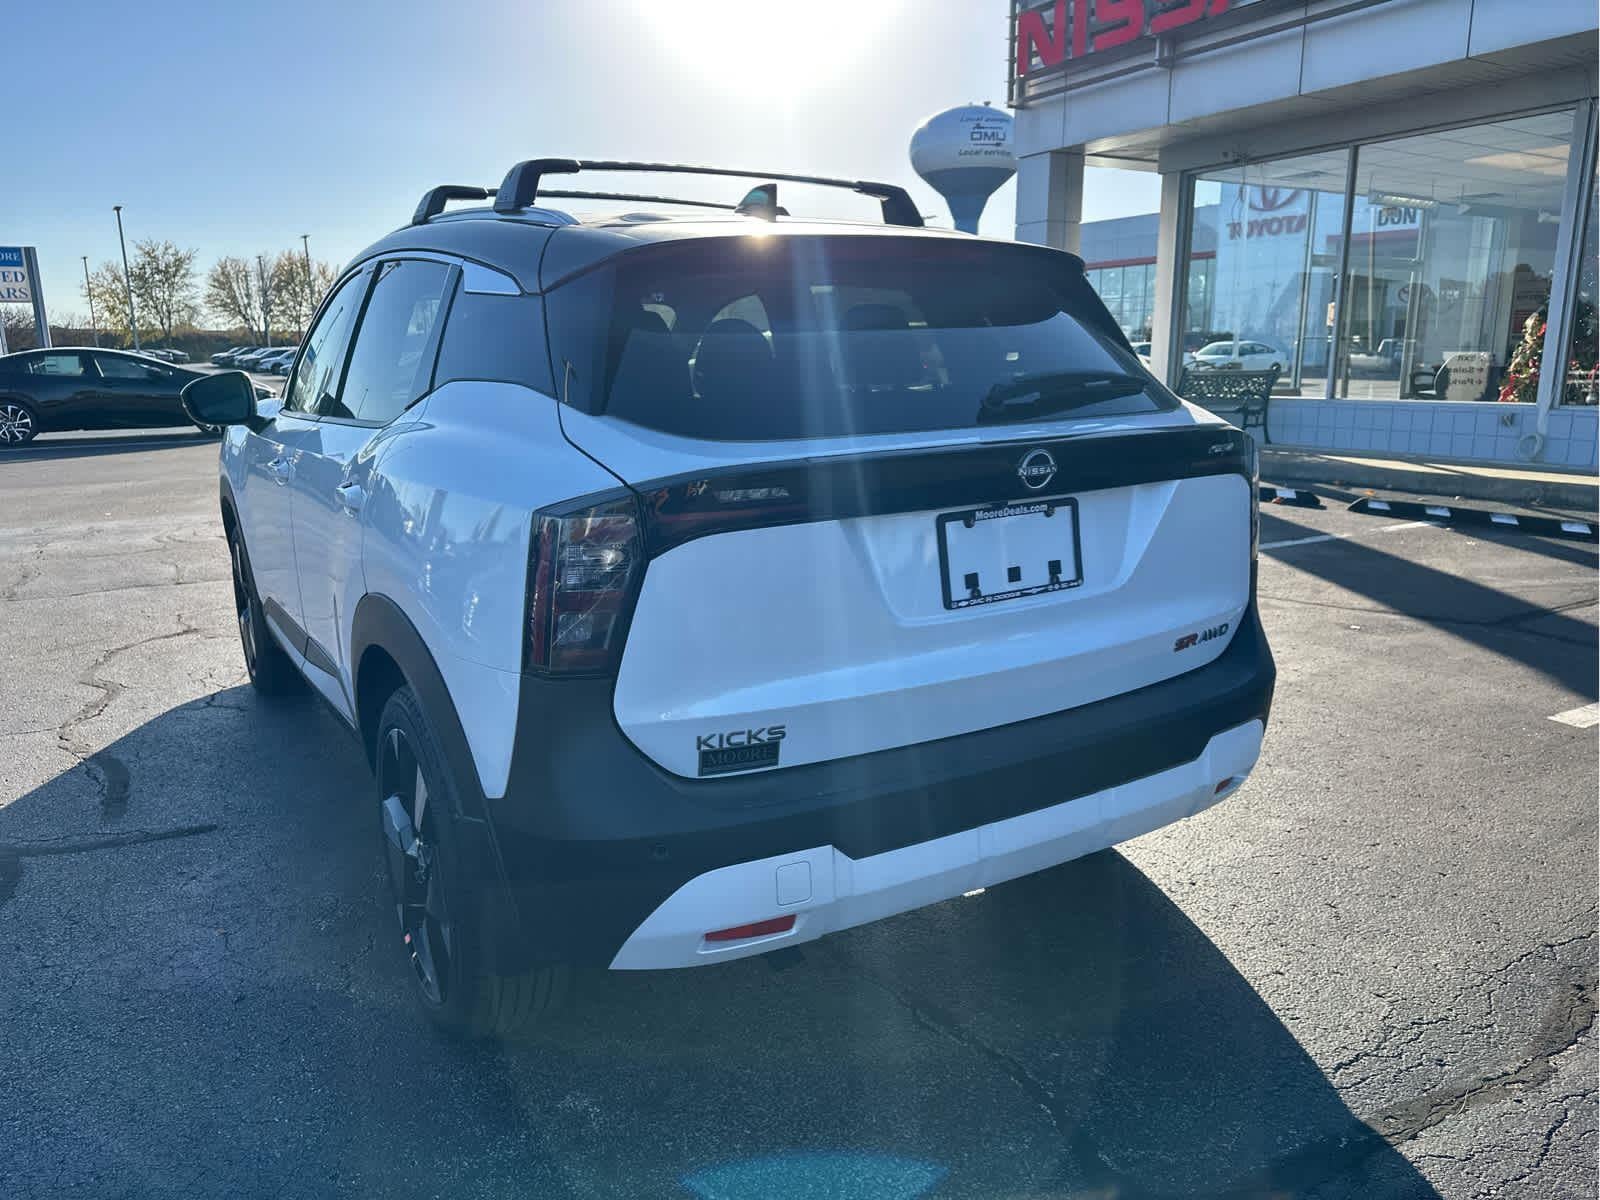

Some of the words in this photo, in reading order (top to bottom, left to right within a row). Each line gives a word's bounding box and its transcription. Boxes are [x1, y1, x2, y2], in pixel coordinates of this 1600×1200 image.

[1018, 466, 1057, 476] NISSAN
[975, 503, 1049, 521] MooreDeals.com
[1173, 631, 1199, 653] SR
[1198, 622, 1229, 644] AWD
[696, 724, 786, 751] KICKS
